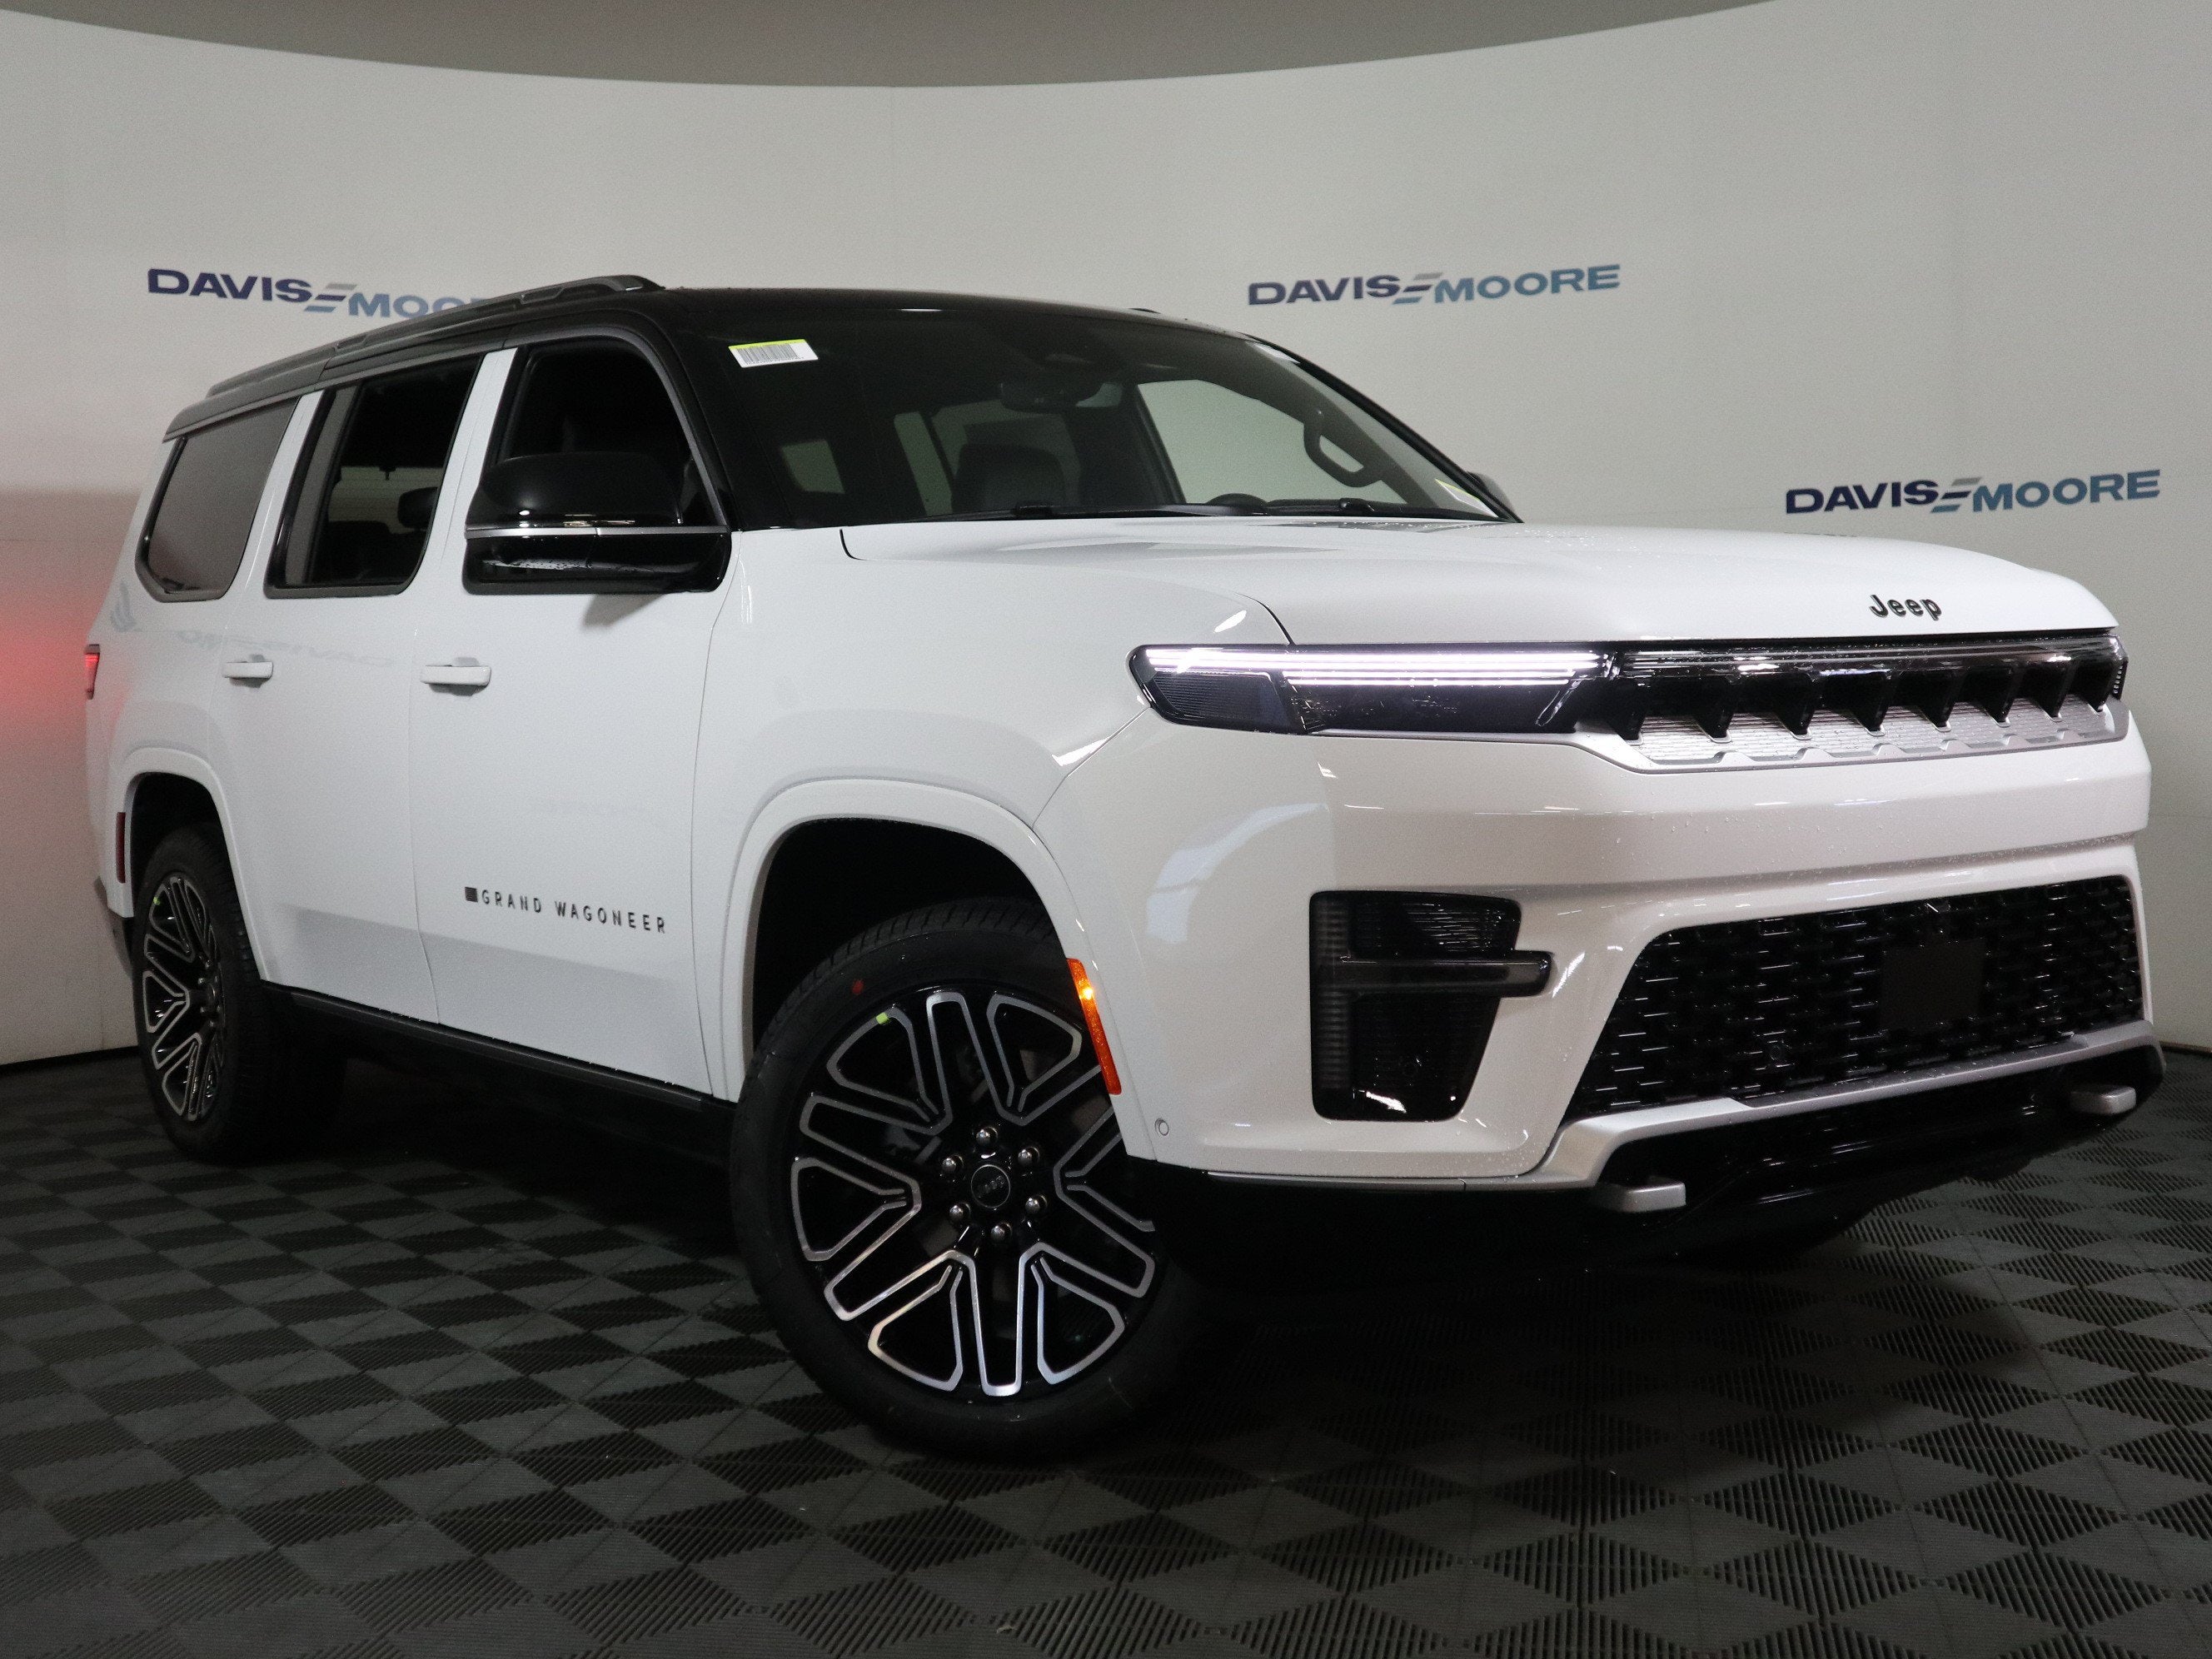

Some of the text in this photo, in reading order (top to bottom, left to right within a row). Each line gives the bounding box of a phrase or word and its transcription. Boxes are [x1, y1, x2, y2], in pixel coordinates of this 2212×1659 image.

[147, 267, 485, 318] DAVIS MOO
[1248, 264, 1621, 306] DAVIS MOORE
[1786, 469, 2160, 514] DAVIS MOORE
[1869, 594, 1942, 620] Jeep
[481, 889, 665, 934] GRAND WAGONEER
